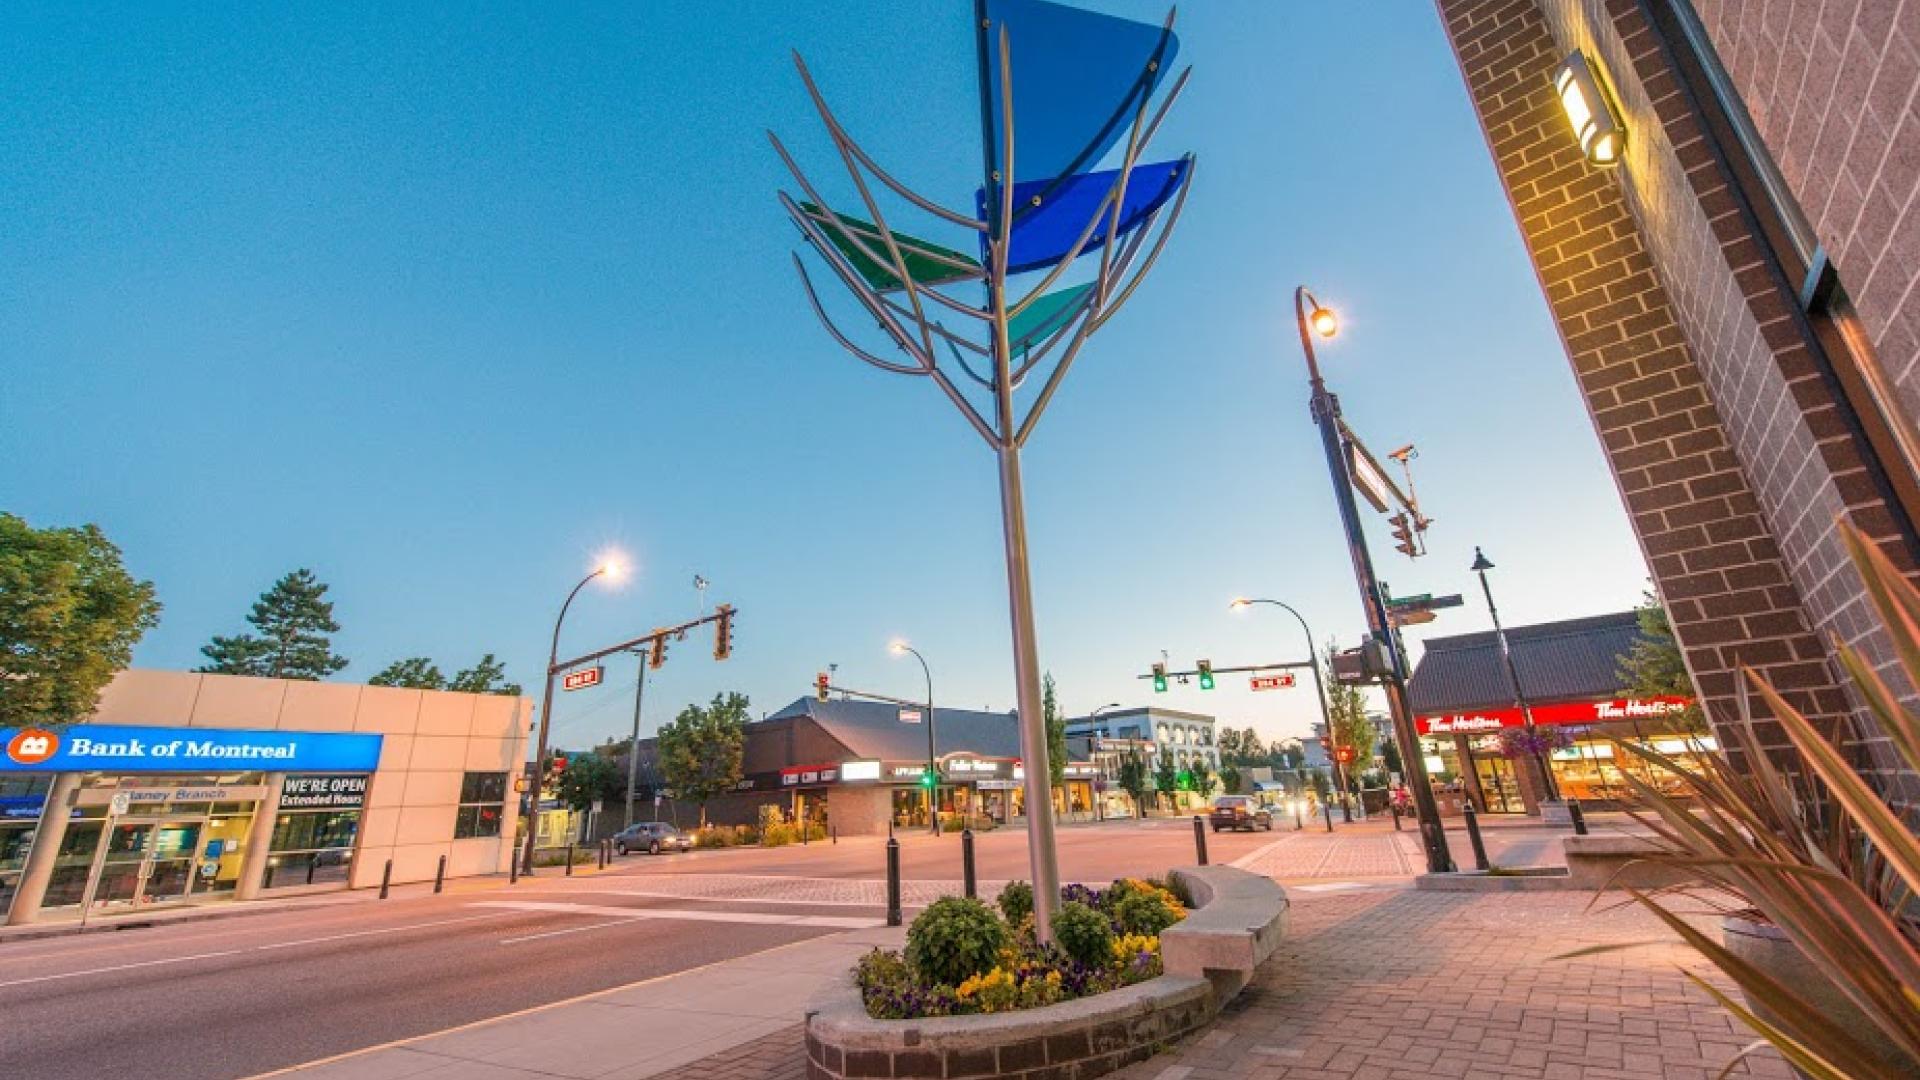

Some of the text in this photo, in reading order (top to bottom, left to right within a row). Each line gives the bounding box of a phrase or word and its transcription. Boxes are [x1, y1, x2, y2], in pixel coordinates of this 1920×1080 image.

[1594, 701, 1625, 718] Tim
[1426, 715, 1503, 734] Tim Hortons
[68, 738, 297, 759] Bank of Montreal
[285, 778, 367, 792] WE'RE OPEN
[175, 788, 227, 800] Branch
[281, 793, 362, 806] Extended Hours
